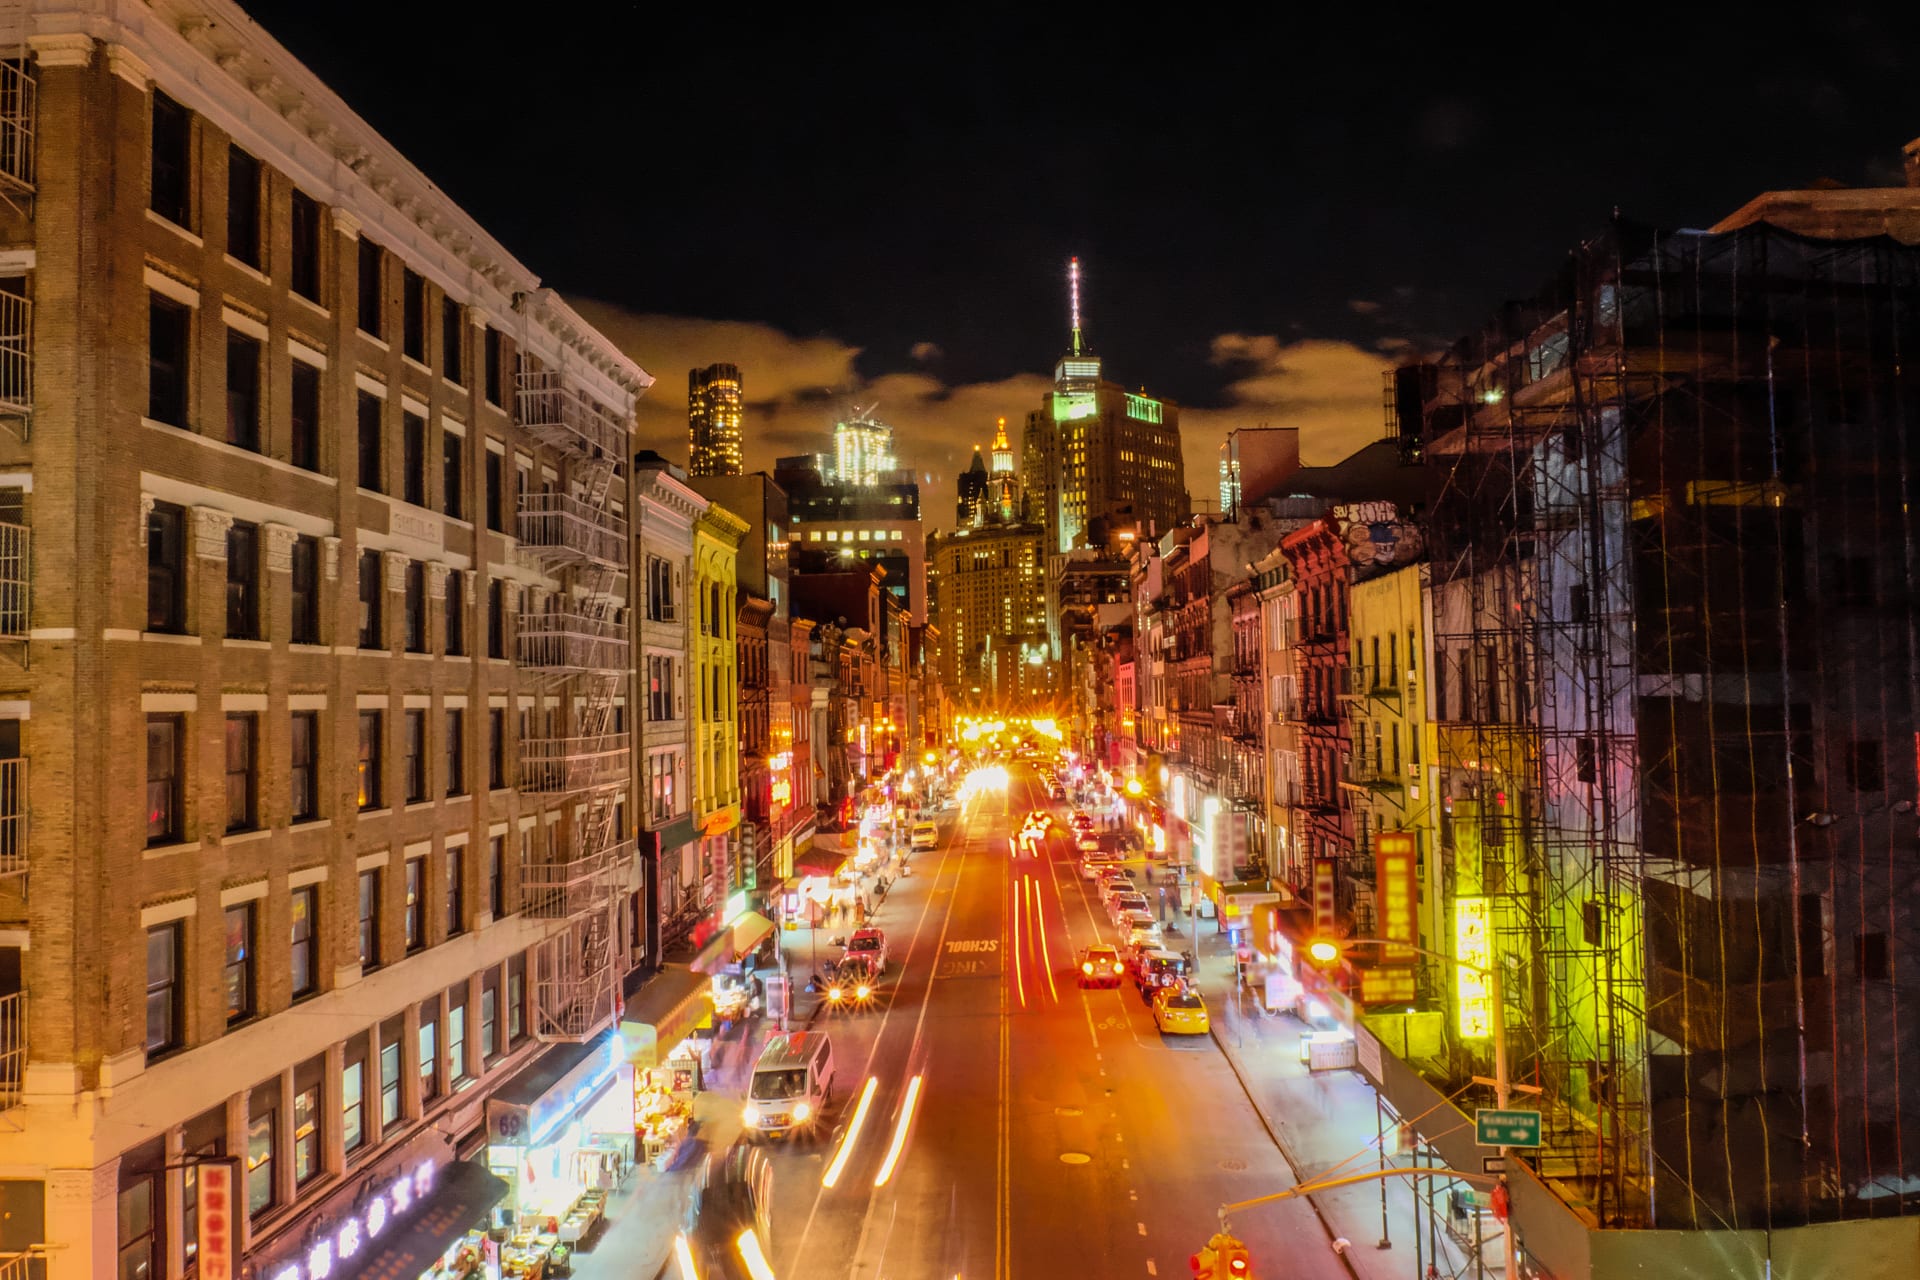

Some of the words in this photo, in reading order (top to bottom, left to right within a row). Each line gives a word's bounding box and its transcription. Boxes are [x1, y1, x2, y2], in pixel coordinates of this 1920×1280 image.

[946, 940, 998, 952] SCHOOL
[500, 1115, 520, 1137] 69
[1482, 1115, 1535, 1127] MANHATTAN
